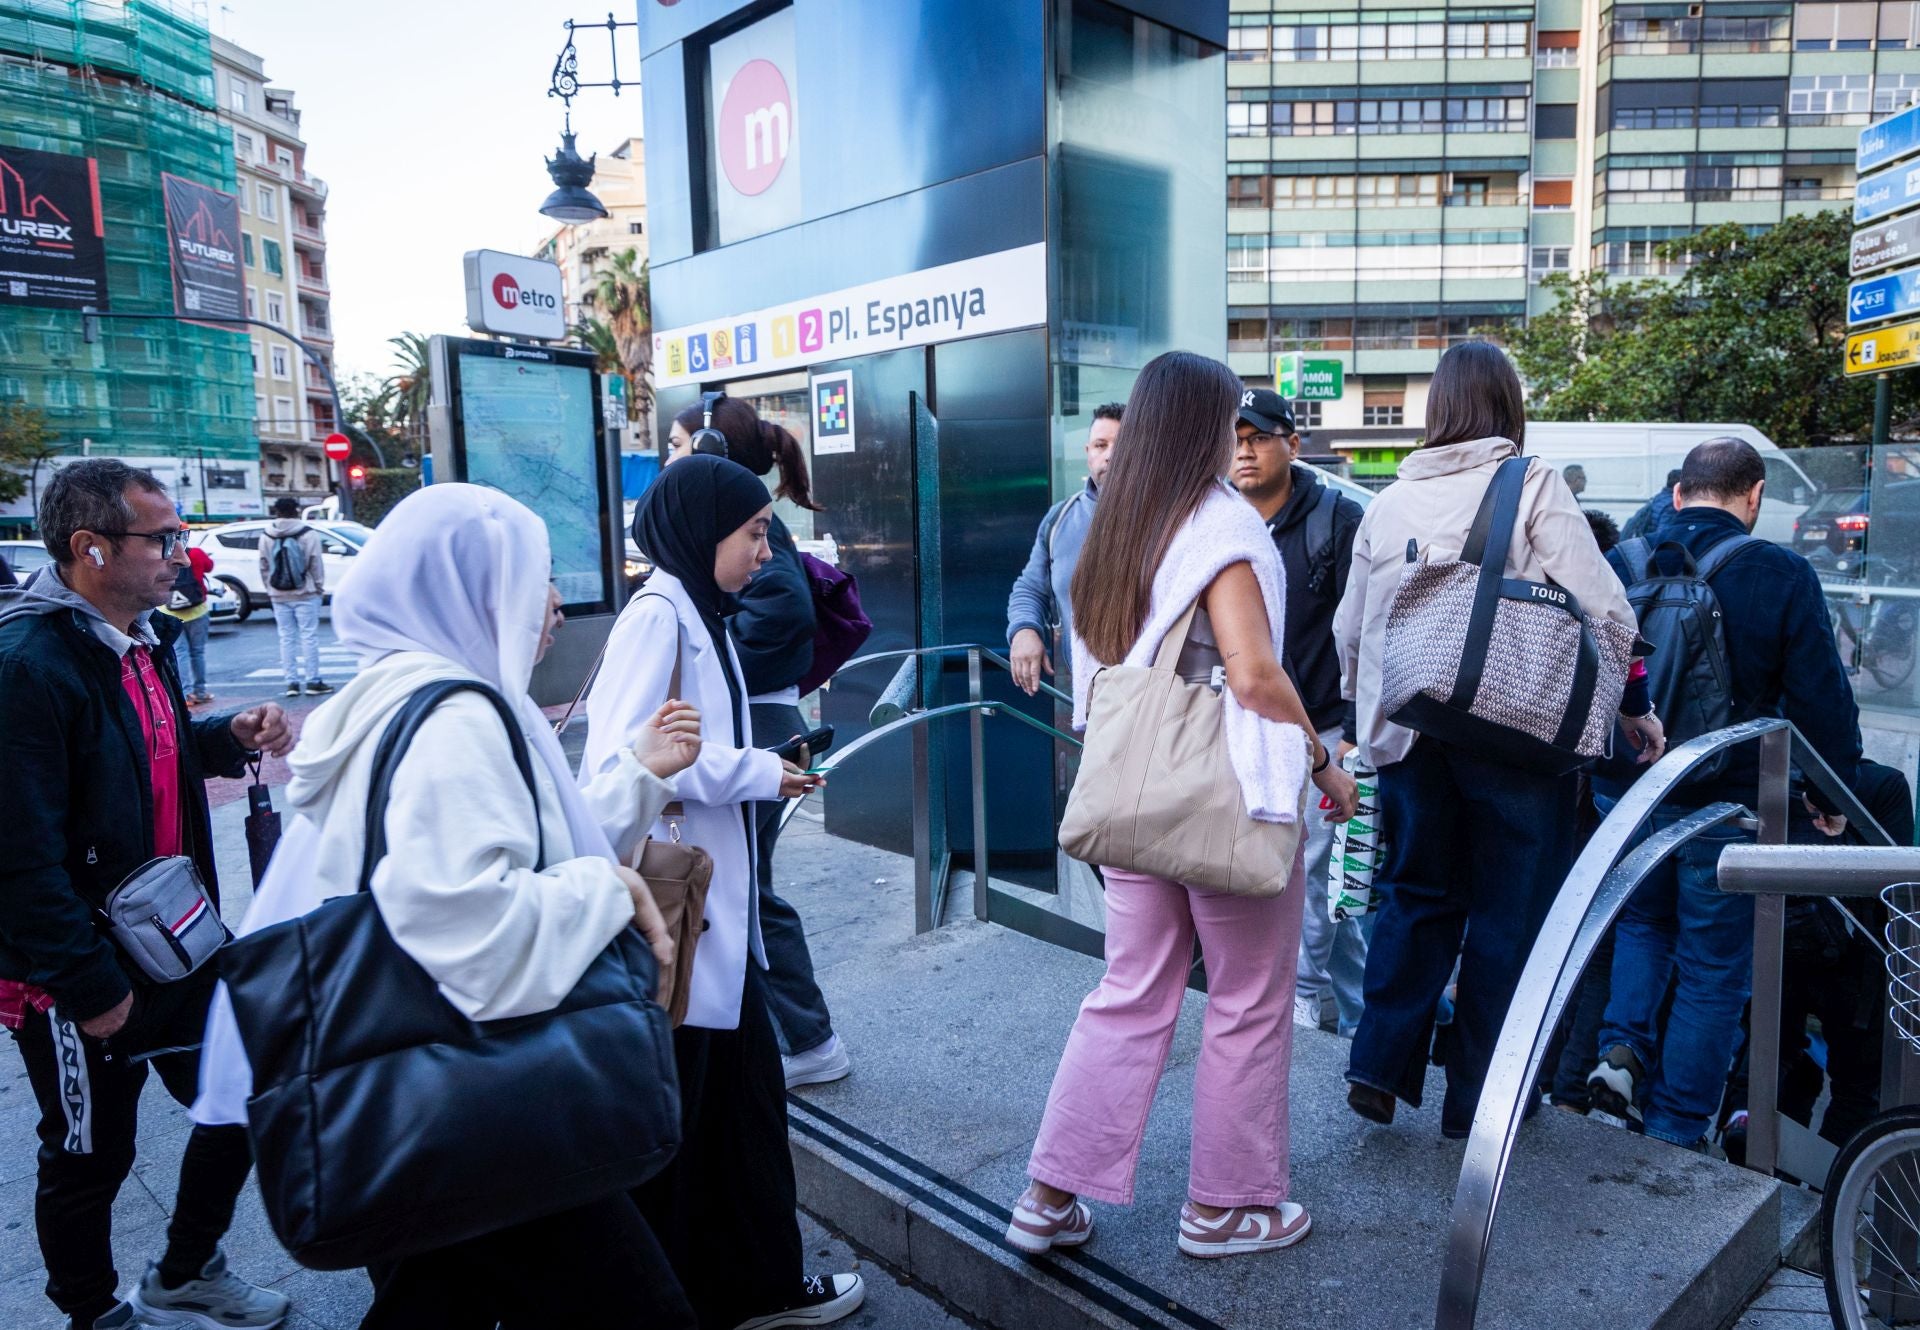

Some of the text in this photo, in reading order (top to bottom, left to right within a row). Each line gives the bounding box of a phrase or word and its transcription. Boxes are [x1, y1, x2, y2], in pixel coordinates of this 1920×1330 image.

[179, 238, 235, 264] FUTUREX
[1855, 229, 1898, 253] Palau de
[1853, 242, 1908, 268] Congressos
[502, 286, 556, 308] metro
[829, 287, 986, 343] Pl. Espanya
[803, 316, 818, 348] 2
[1304, 386, 1337, 397] CAJAL
[1530, 585, 1567, 604] TOUS
